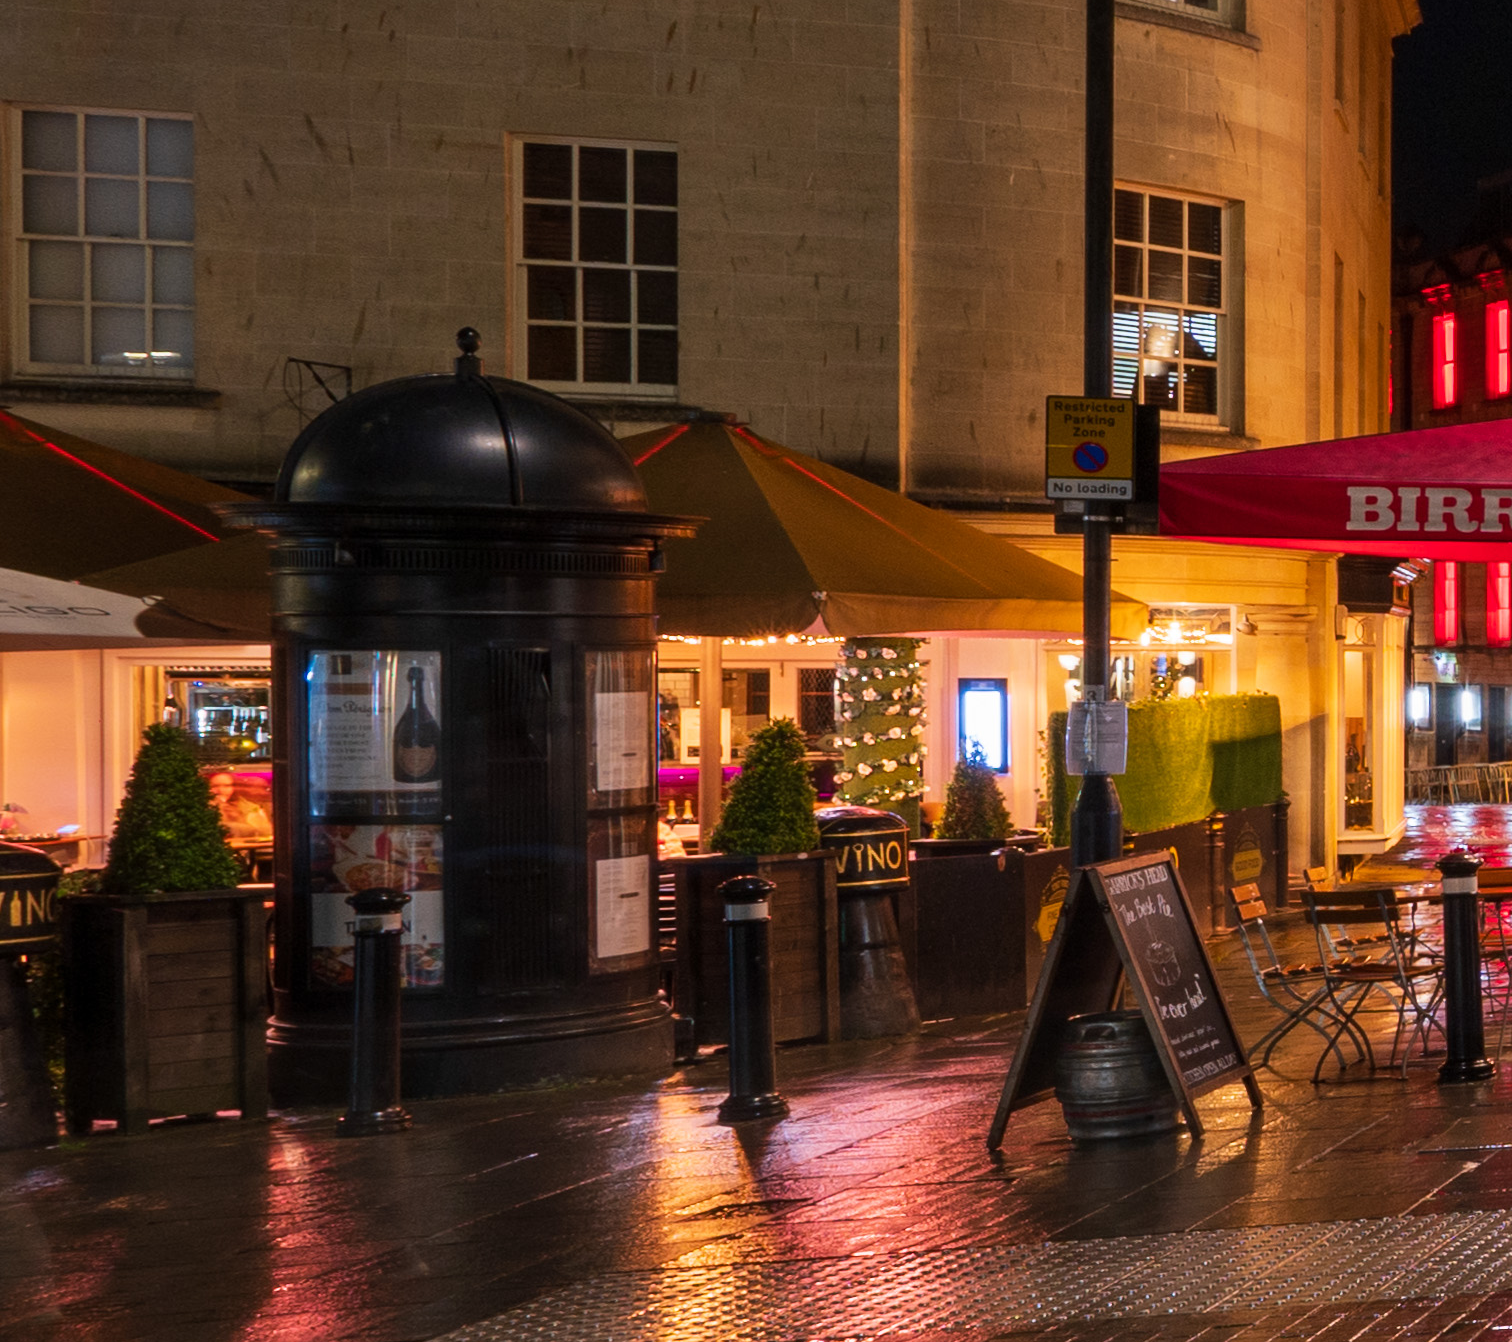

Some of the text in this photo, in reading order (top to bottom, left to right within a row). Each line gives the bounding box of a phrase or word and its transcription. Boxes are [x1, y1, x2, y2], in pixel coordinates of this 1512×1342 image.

[1054, 401, 1125, 413] Restricted
[1064, 414, 1116, 427] Parking
[1073, 427, 1106, 438] Zone
[1053, 482, 1127, 496] No loading
